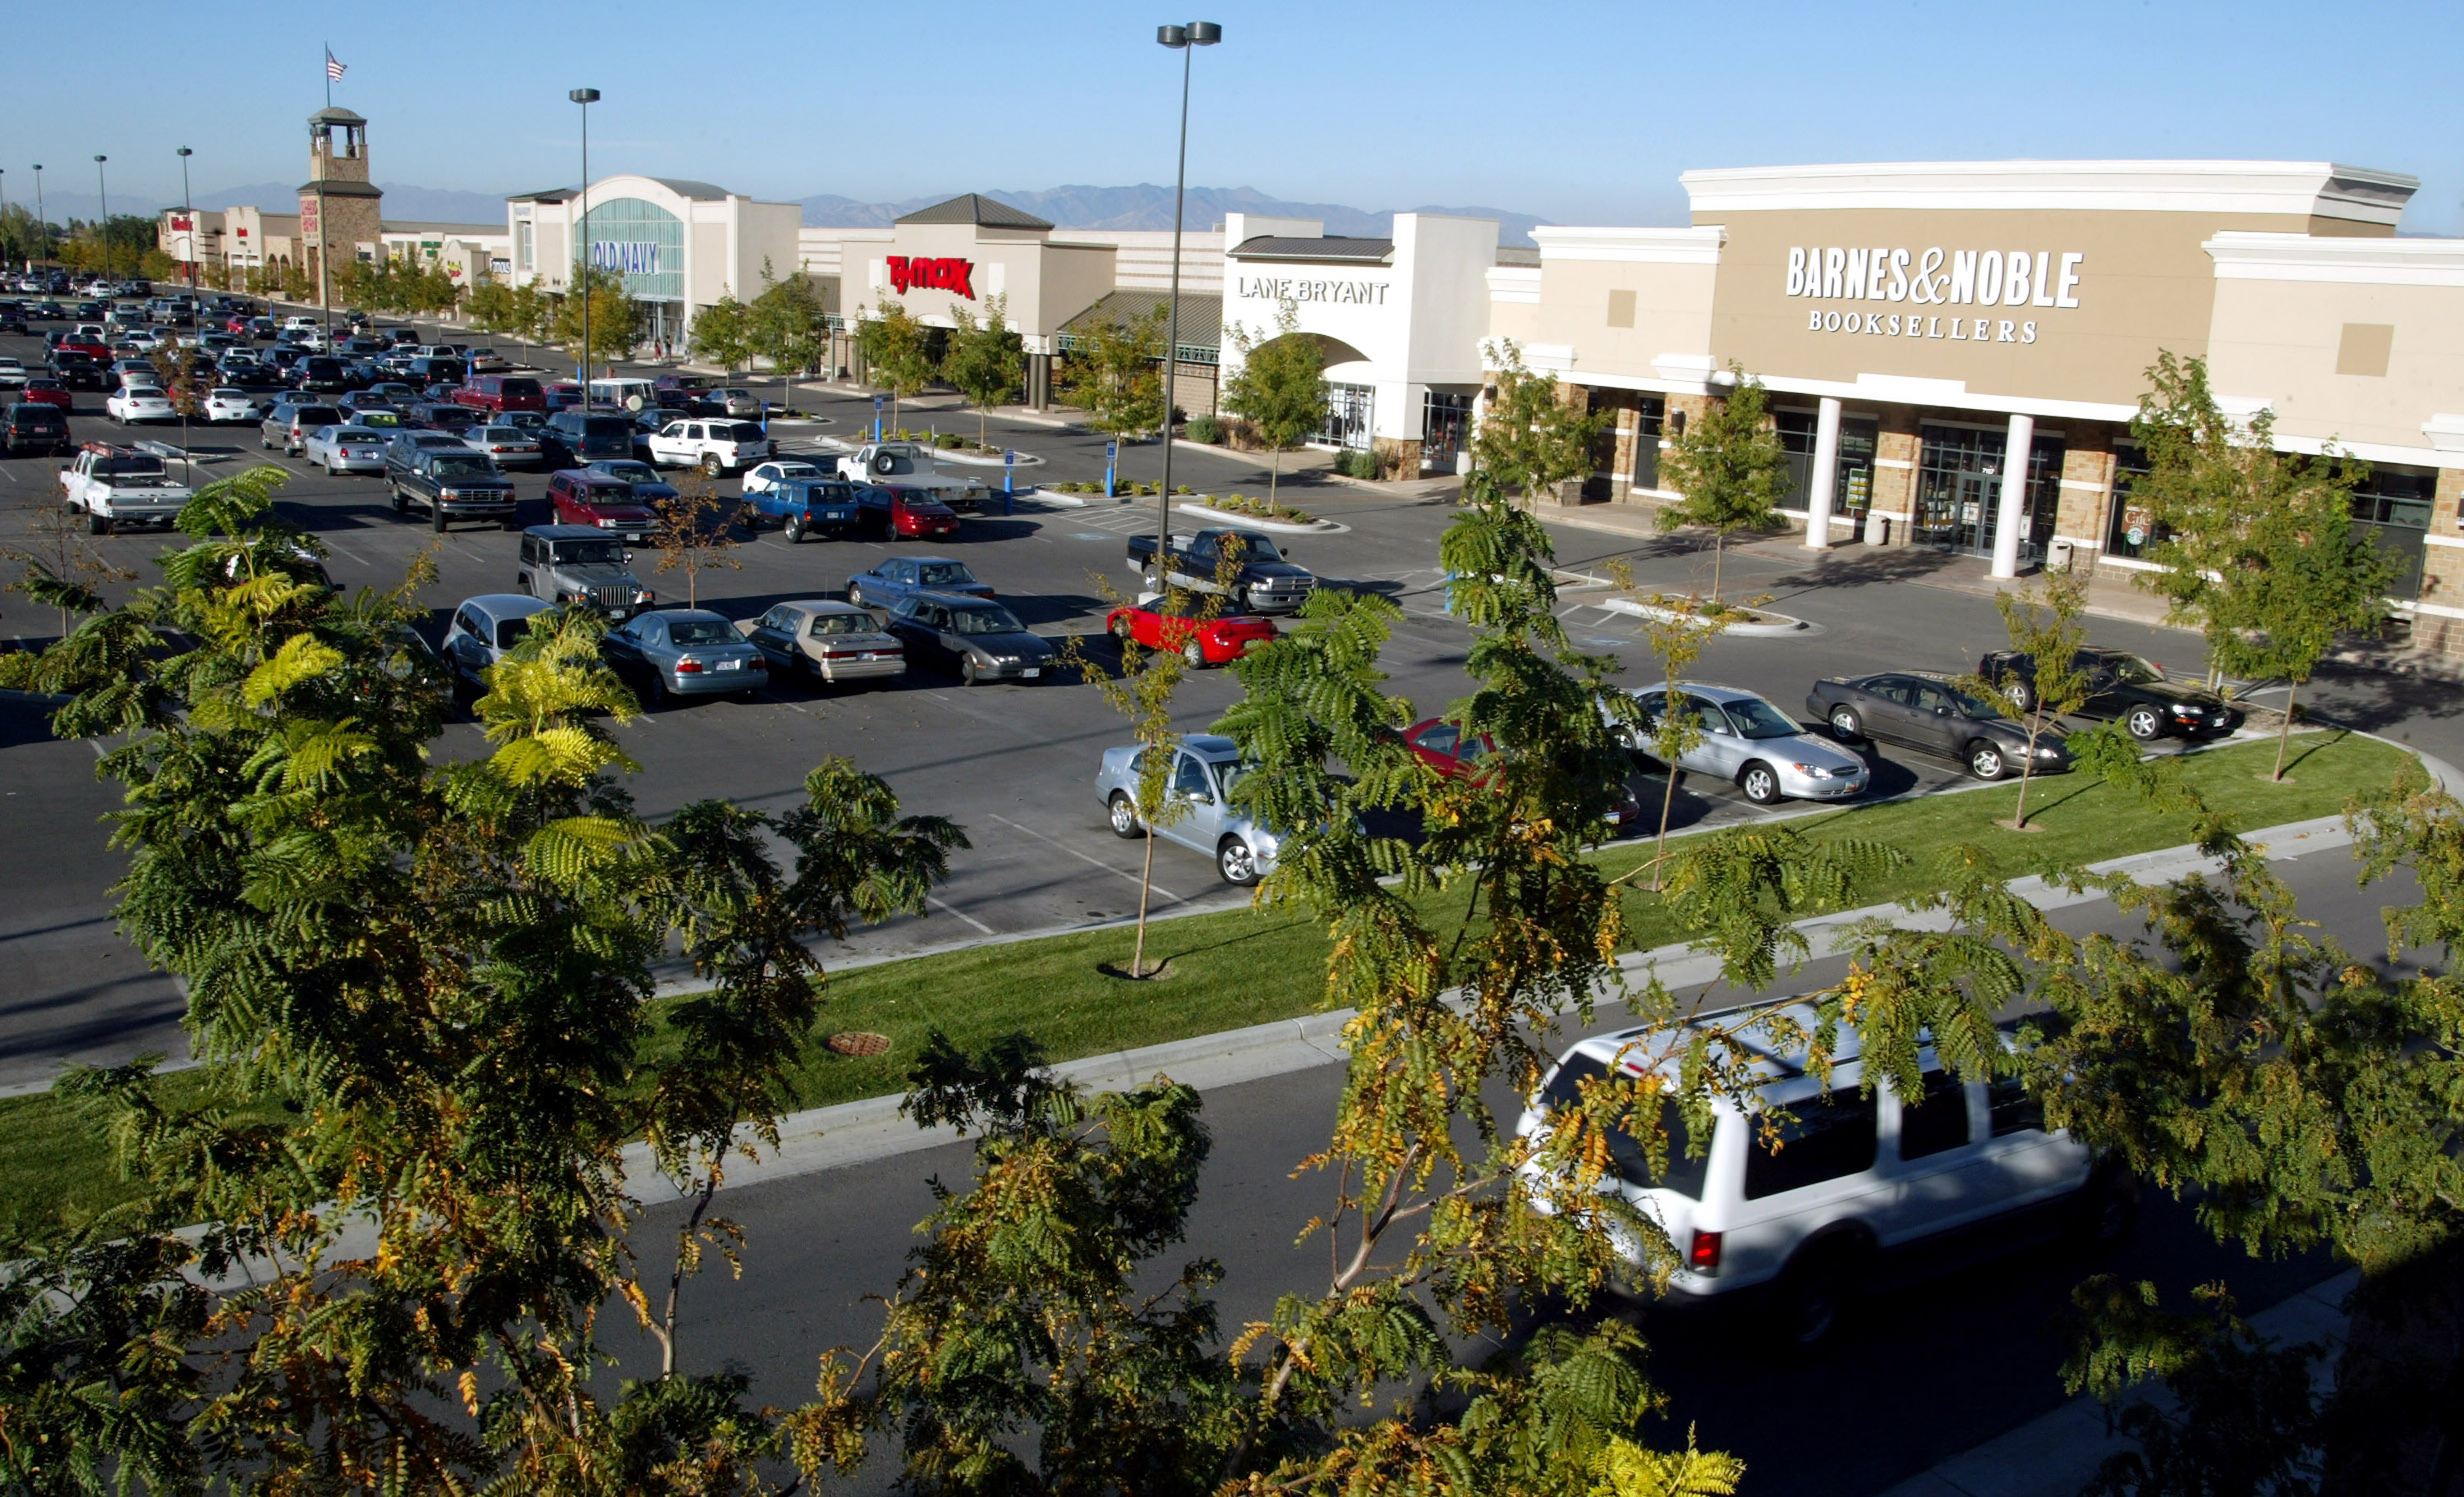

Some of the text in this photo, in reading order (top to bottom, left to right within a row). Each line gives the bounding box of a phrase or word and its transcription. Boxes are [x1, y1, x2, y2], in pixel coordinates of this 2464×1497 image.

[594, 241, 657, 275] OLD NAVY
[1239, 276, 1391, 305] LANE BRYANT
[1808, 310, 2039, 345] BOOKSELLERS
